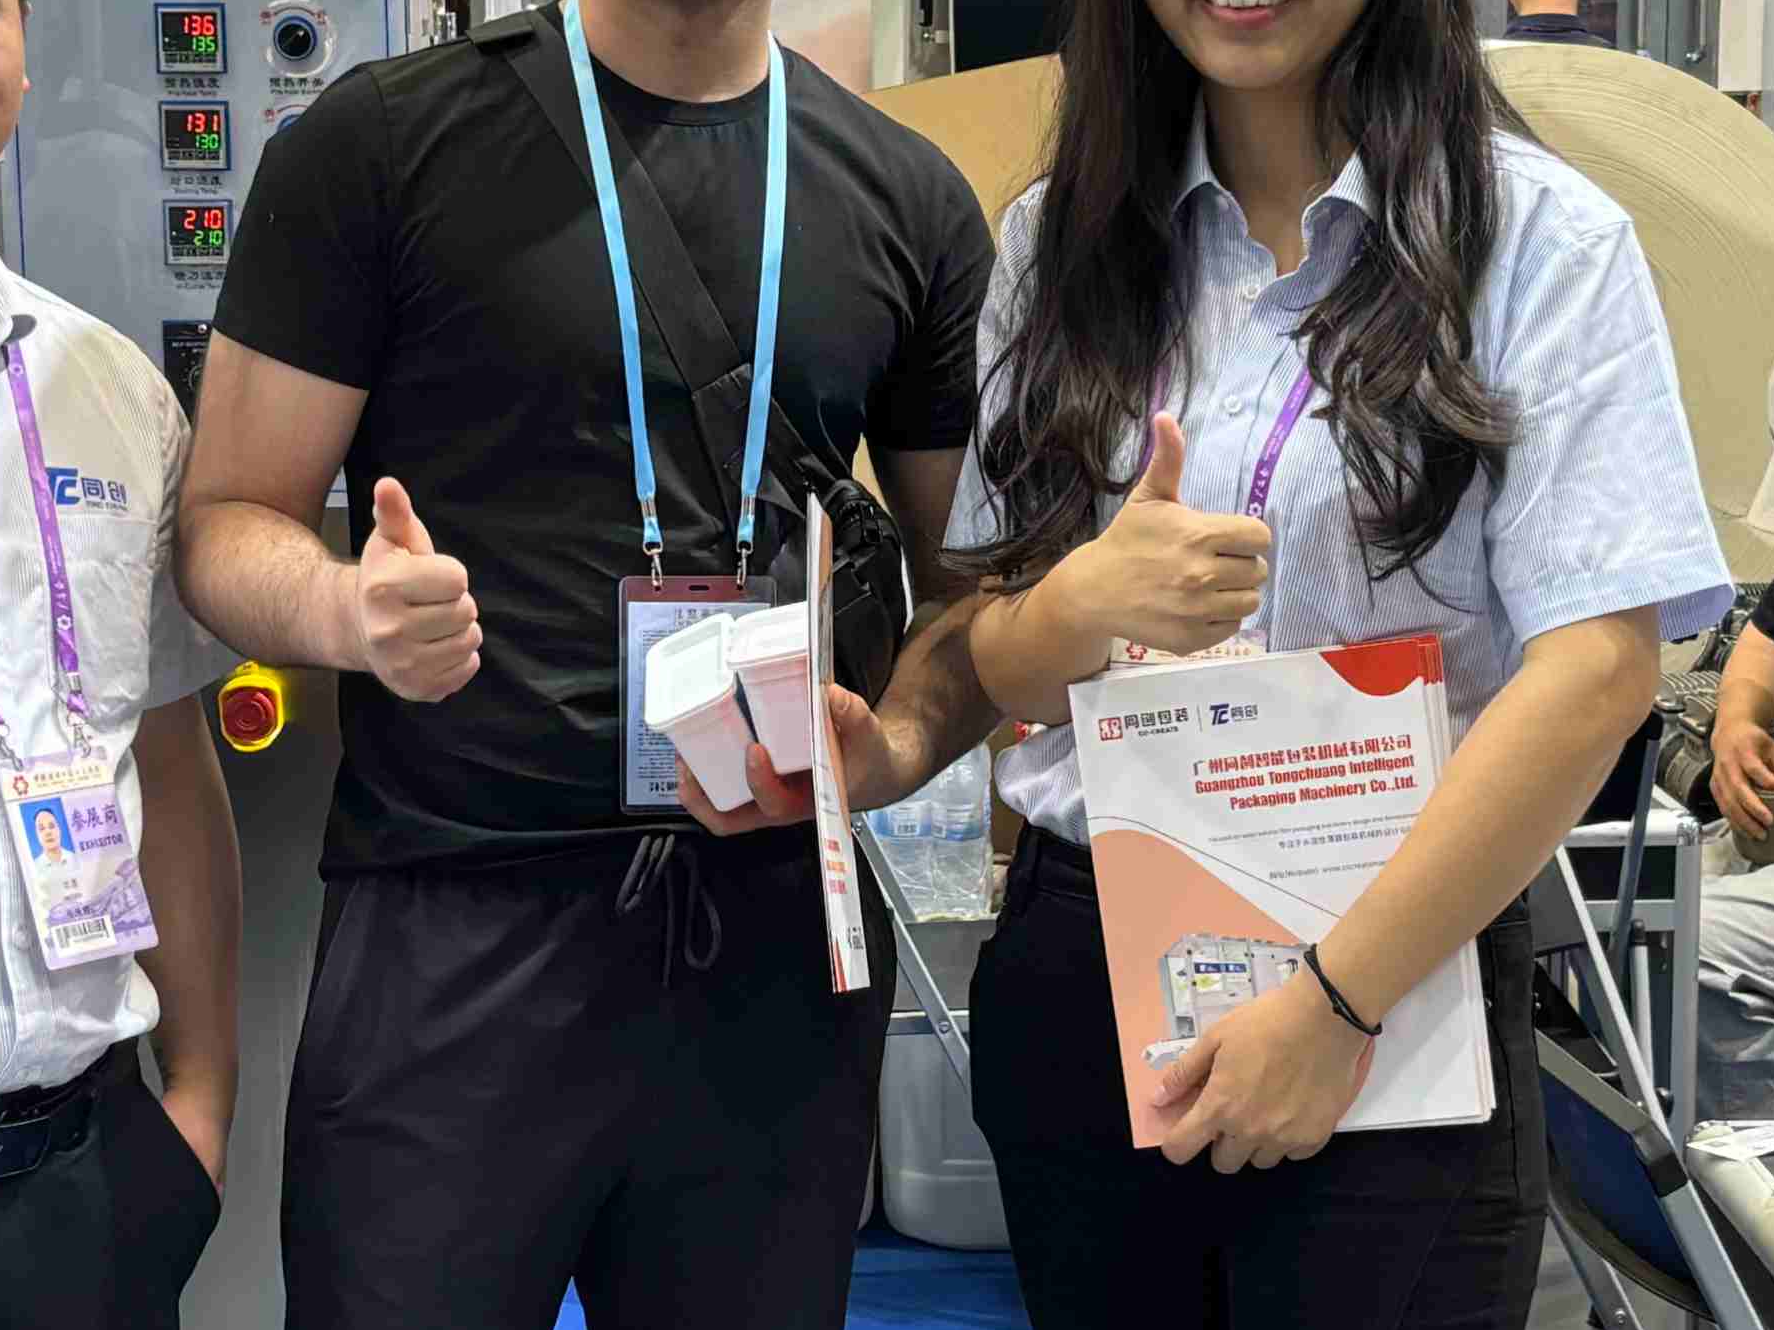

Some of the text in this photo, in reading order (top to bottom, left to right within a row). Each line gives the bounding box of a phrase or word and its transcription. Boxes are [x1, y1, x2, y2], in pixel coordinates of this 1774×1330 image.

[184, 15, 215, 36] 136
[192, 37, 216, 51] 135
[187, 113, 219, 133] 131
[195, 134, 219, 149] 130
[184, 209, 222, 230] 210
[194, 230, 223, 246] 210
[1194, 755, 1416, 795] Guangzhou Tongchuang Intelligent
[1229, 791, 1297, 812] Packaging
[1299, 783, 1367, 804] Machinery
[72, 804, 118, 831] 参展商
